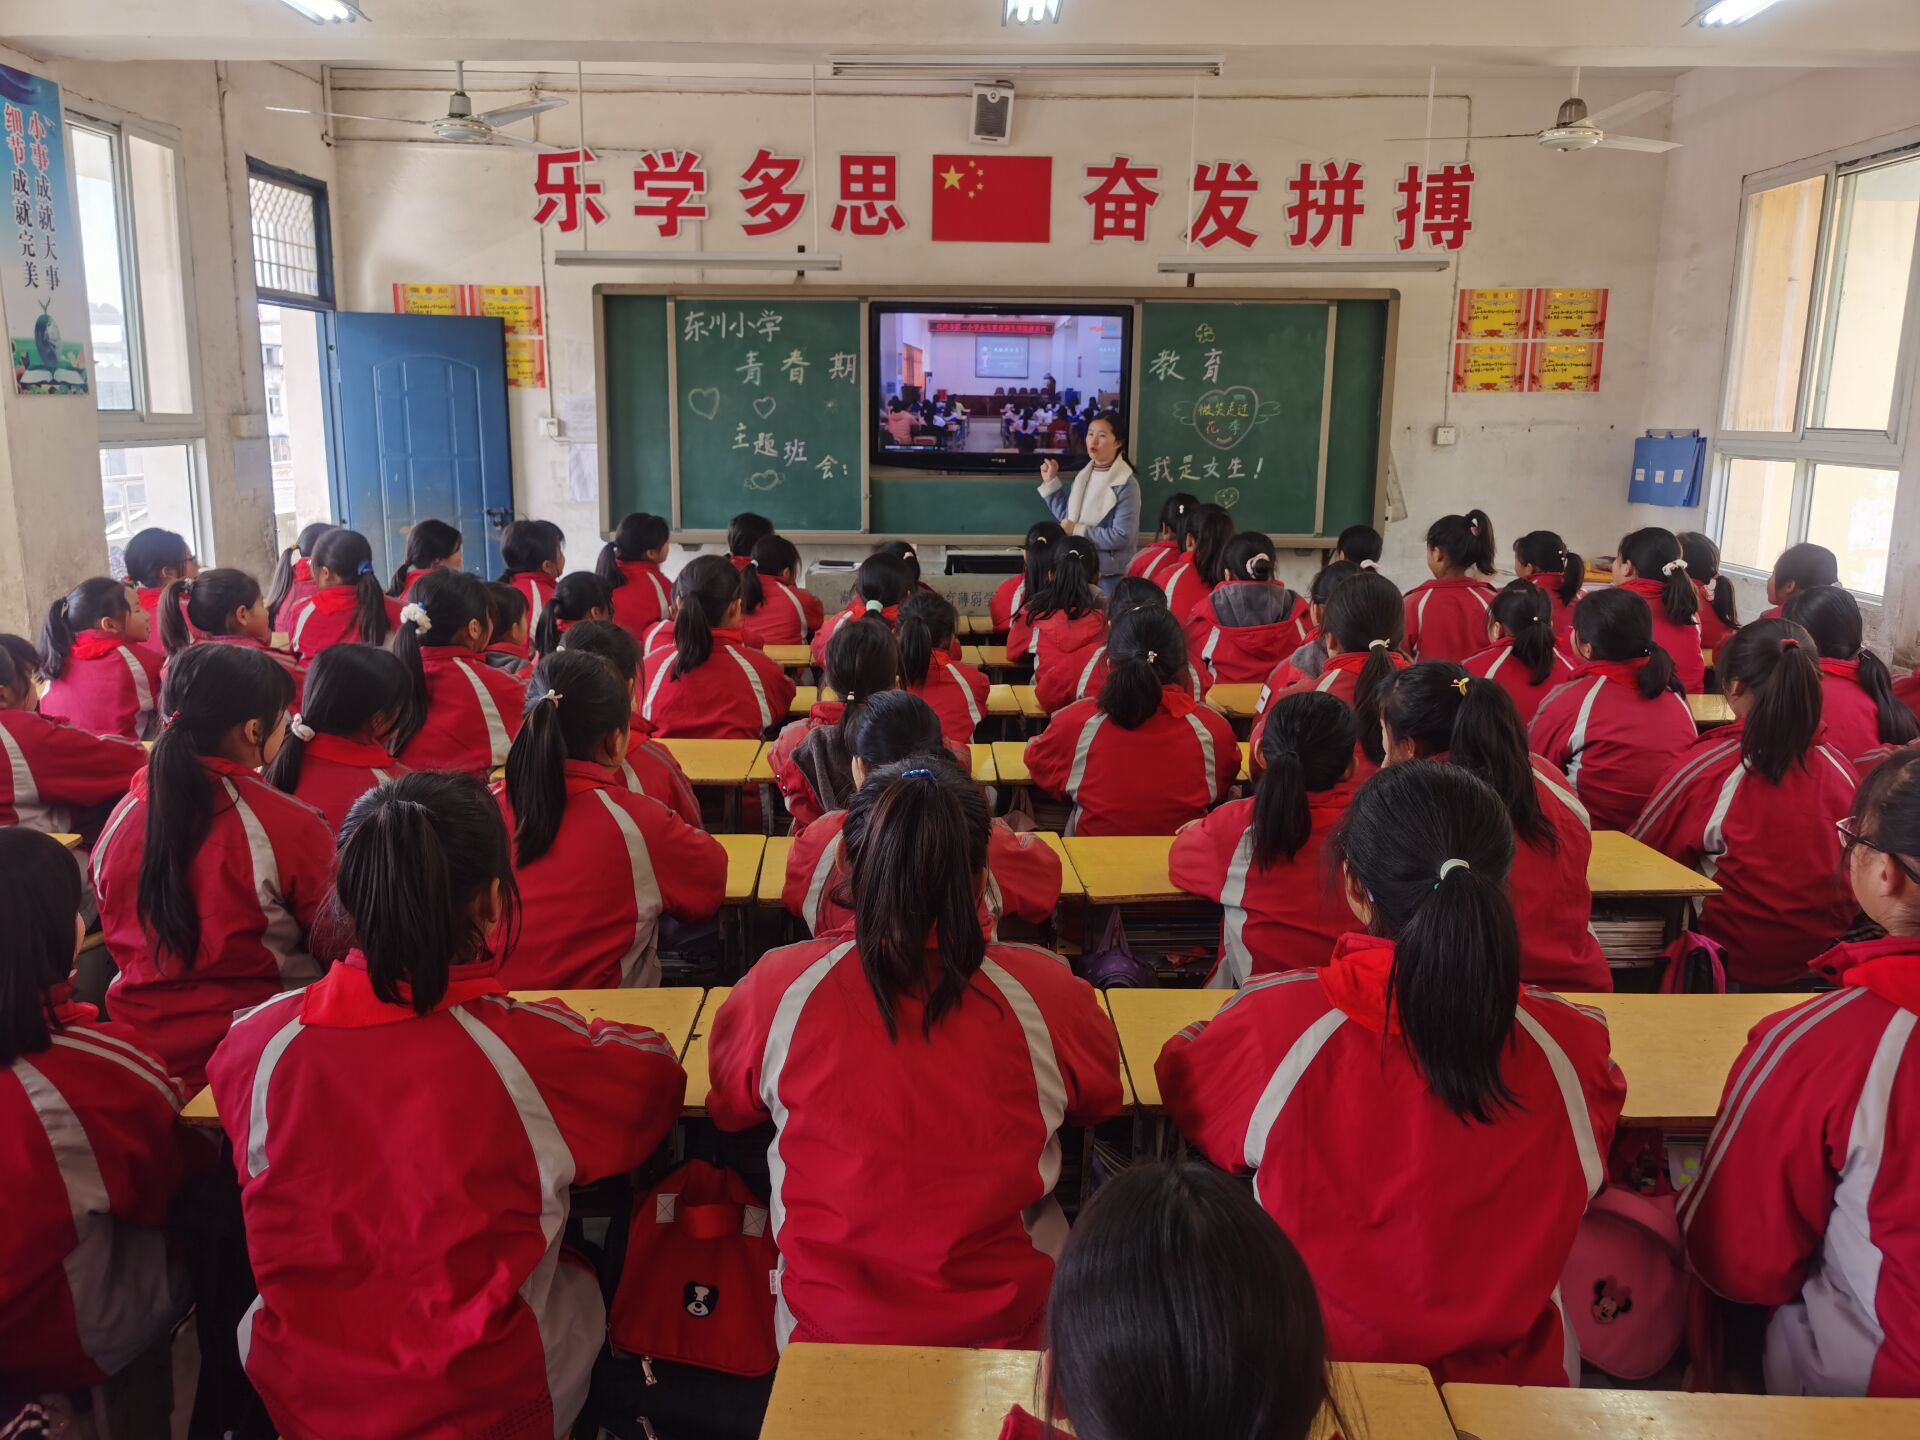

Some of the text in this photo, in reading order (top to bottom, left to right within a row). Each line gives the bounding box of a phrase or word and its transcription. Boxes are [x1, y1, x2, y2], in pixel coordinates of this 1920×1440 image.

[4, 105, 39, 289] 细节成就完美
[28, 111, 61, 291] 小事成就大事
[533, 148, 1475, 250] 乐学多思 奋发拼搏
[684, 309, 783, 342] 东川小学
[735, 349, 858, 386] 青春期
[1149, 347, 1224, 385] 教育
